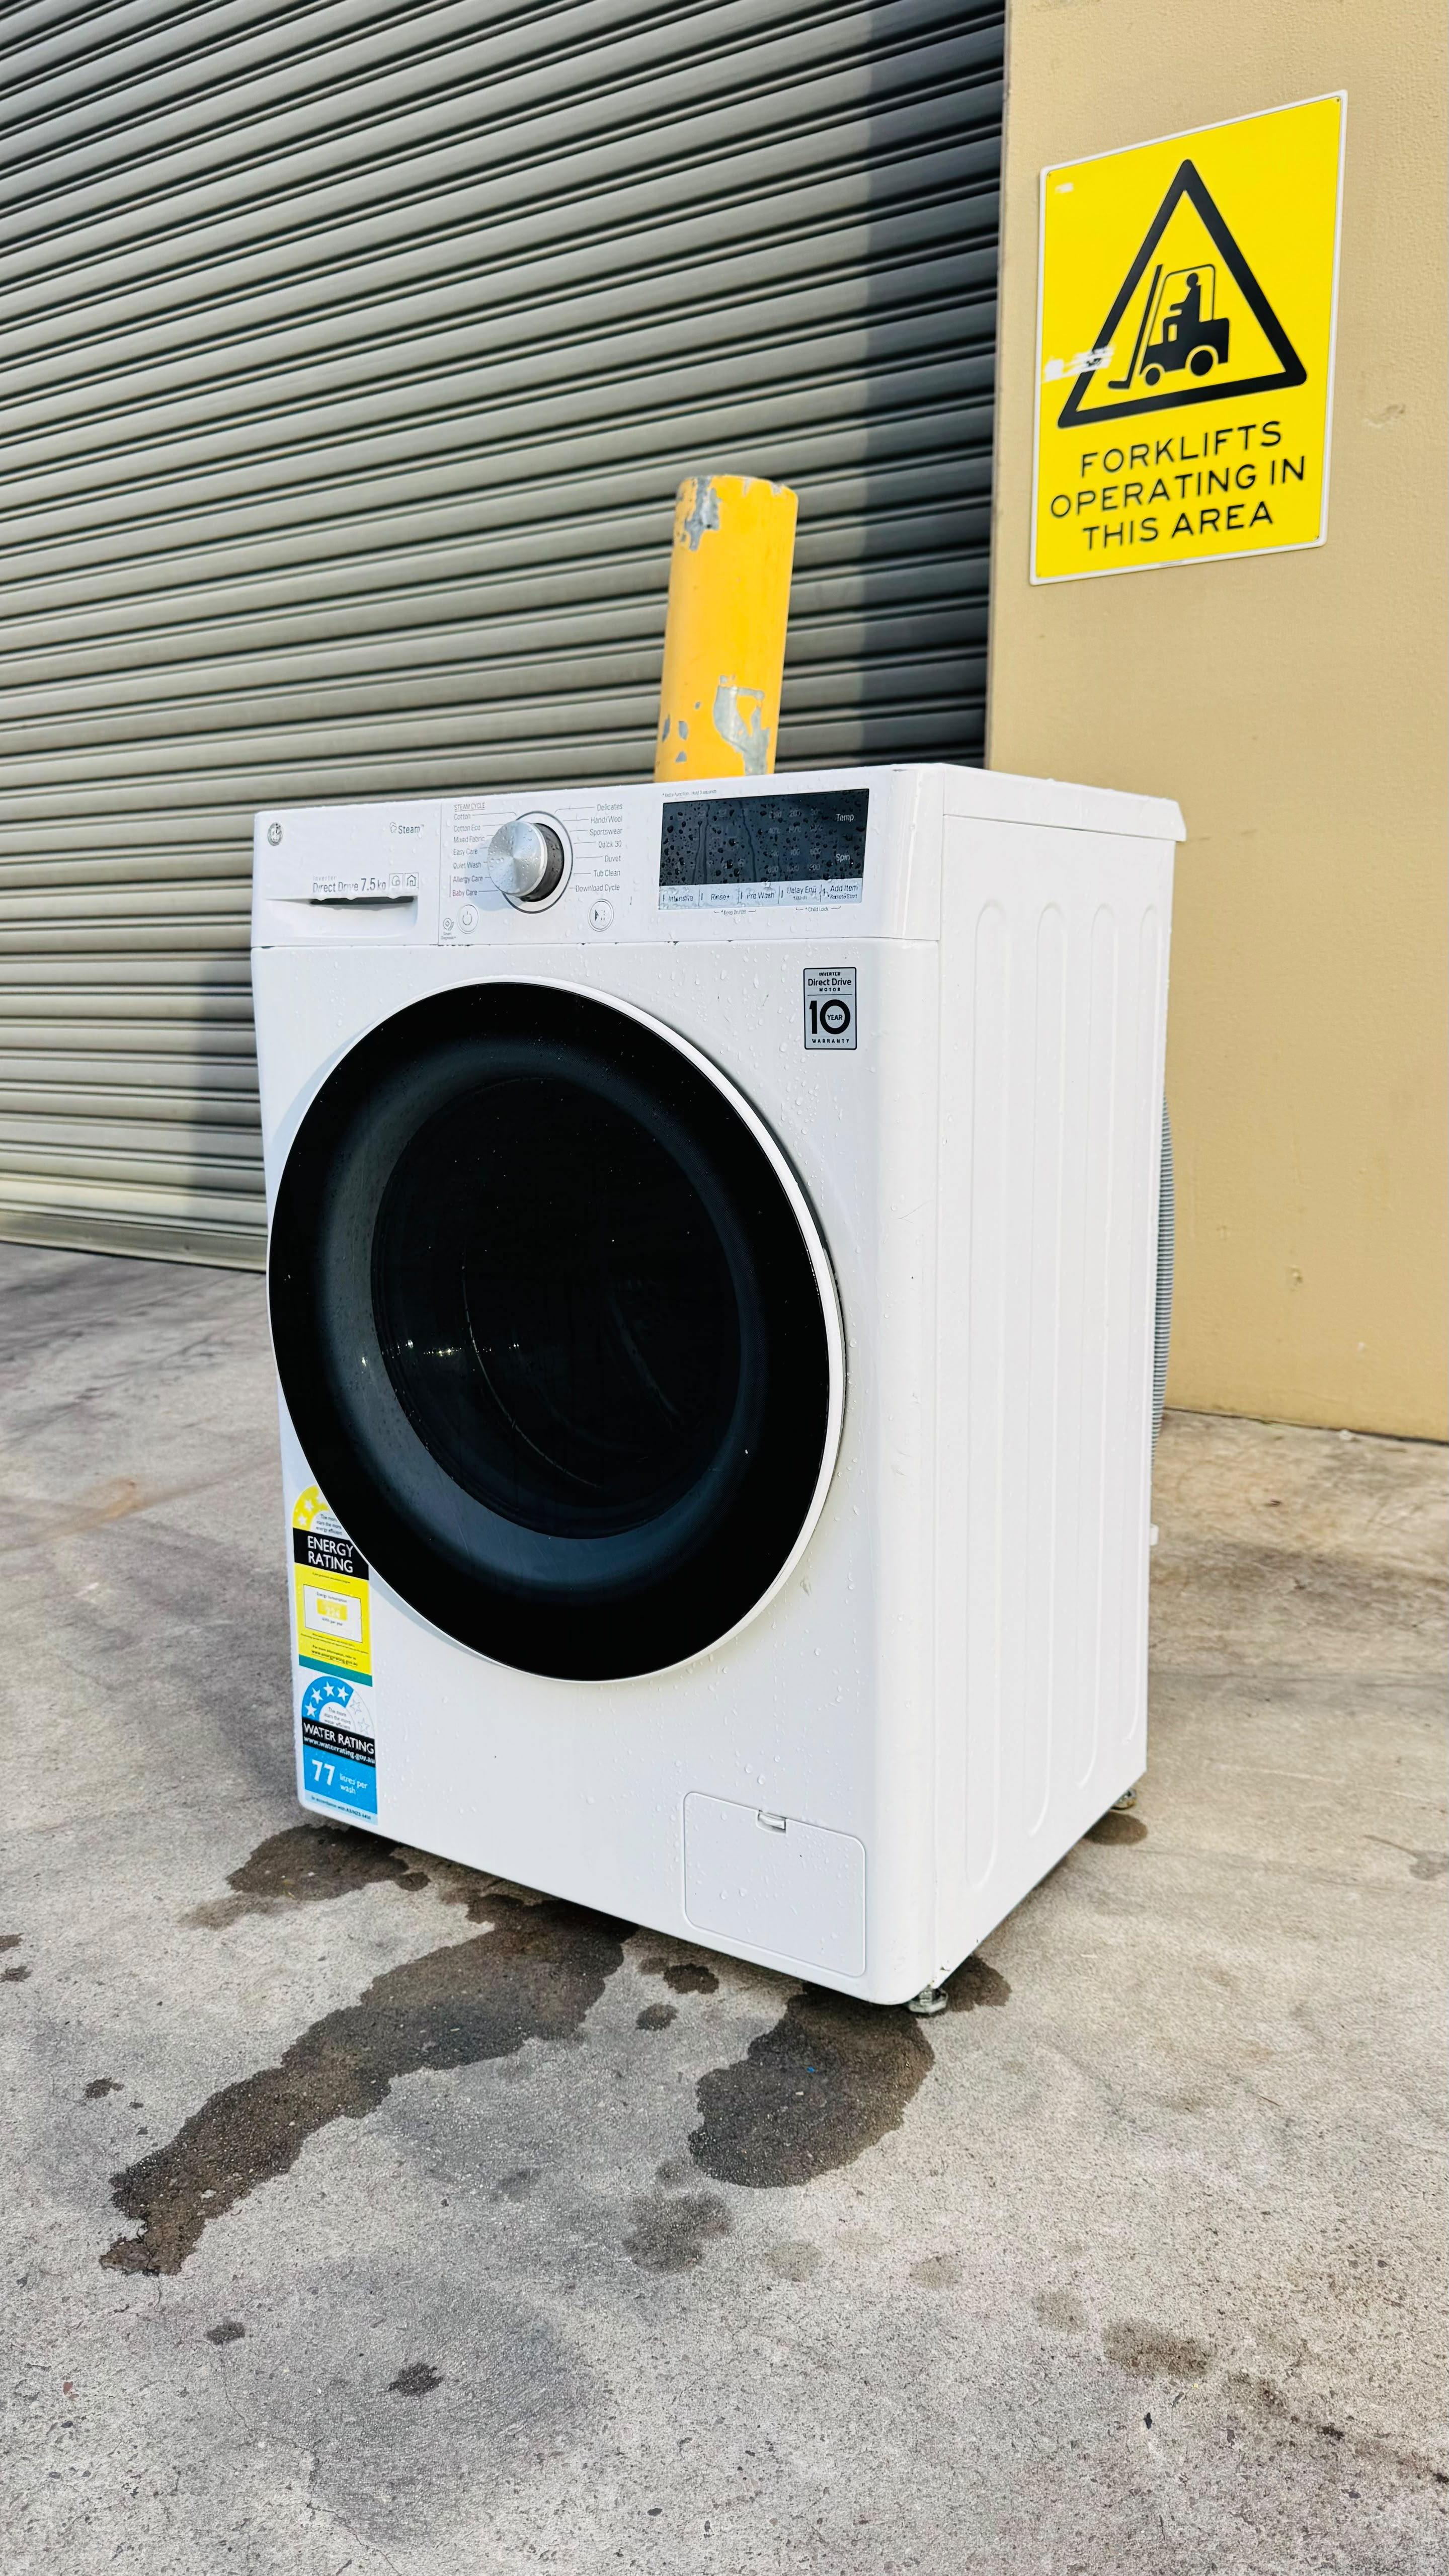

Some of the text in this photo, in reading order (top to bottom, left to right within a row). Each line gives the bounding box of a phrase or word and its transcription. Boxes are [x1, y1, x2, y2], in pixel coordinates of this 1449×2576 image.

[1080, 421, 1282, 478] FORKLIFTS
[1051, 455, 1305, 519] OPERATING IN
[1082, 501, 1273, 550] THIS AREA
[591, 815, 623, 824] Hand/Wool
[836, 813, 854, 822] Temp
[398, 825, 420, 834] Steam
[590, 828, 623, 837] Sportswear
[835, 853, 850, 863] Spin
[312, 882, 336, 893] Direct
[338, 882, 359, 892] Drive
[361, 877, 376, 891] 7.5
[576, 883, 620, 892] Download Cycle
[787, 887, 804, 895] Delay
[809, 999, 851, 1035] 10
[307, 1535, 354, 1558] ENERGY
[308, 1550, 353, 1573] RATING
[303, 1722, 374, 1755] WATER RATING
[303, 1736, 375, 1764] www.waterrating.gov.au
[311, 1758, 336, 1786] 77
[340, 1773, 368, 1789] litres per
[340, 1784, 356, 1795] wash
